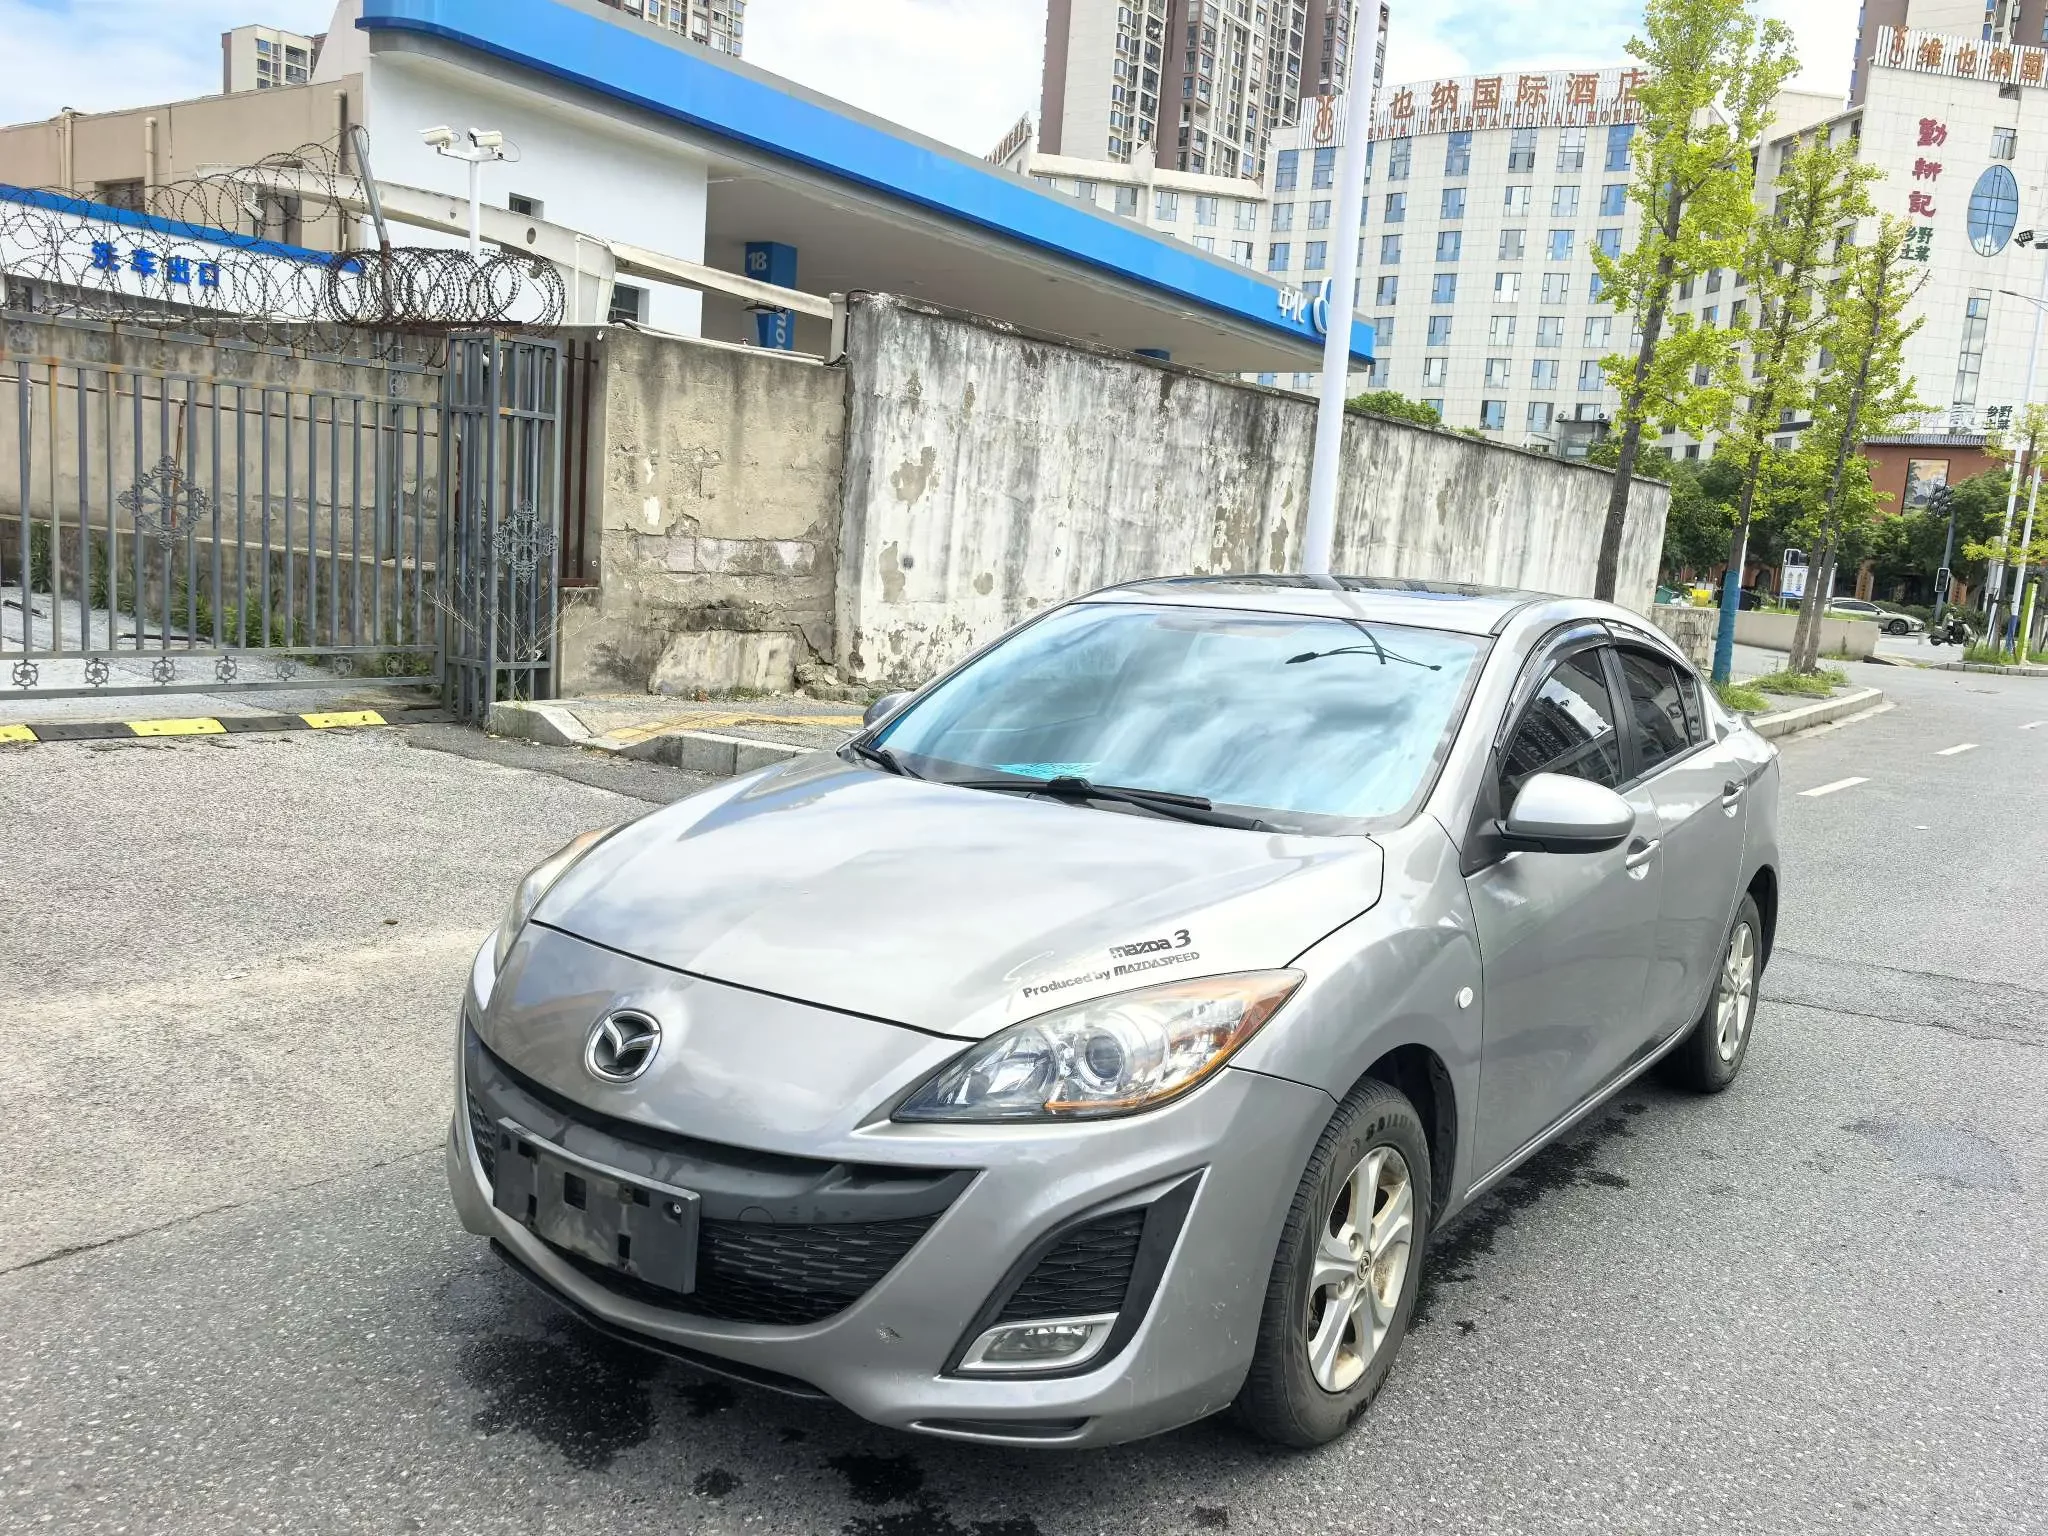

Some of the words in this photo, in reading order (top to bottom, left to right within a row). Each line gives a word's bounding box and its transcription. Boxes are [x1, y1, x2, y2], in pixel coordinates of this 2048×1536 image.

[1371, 67, 1649, 120] 也纳国际酒店
[92, 239, 219, 287] 洗车出口
[748, 251, 767, 271] 18
[1174, 928, 1192, 948] 3
[1022, 973, 1093, 998] Produced
[1113, 951, 1200, 976] MAZDASPEED
